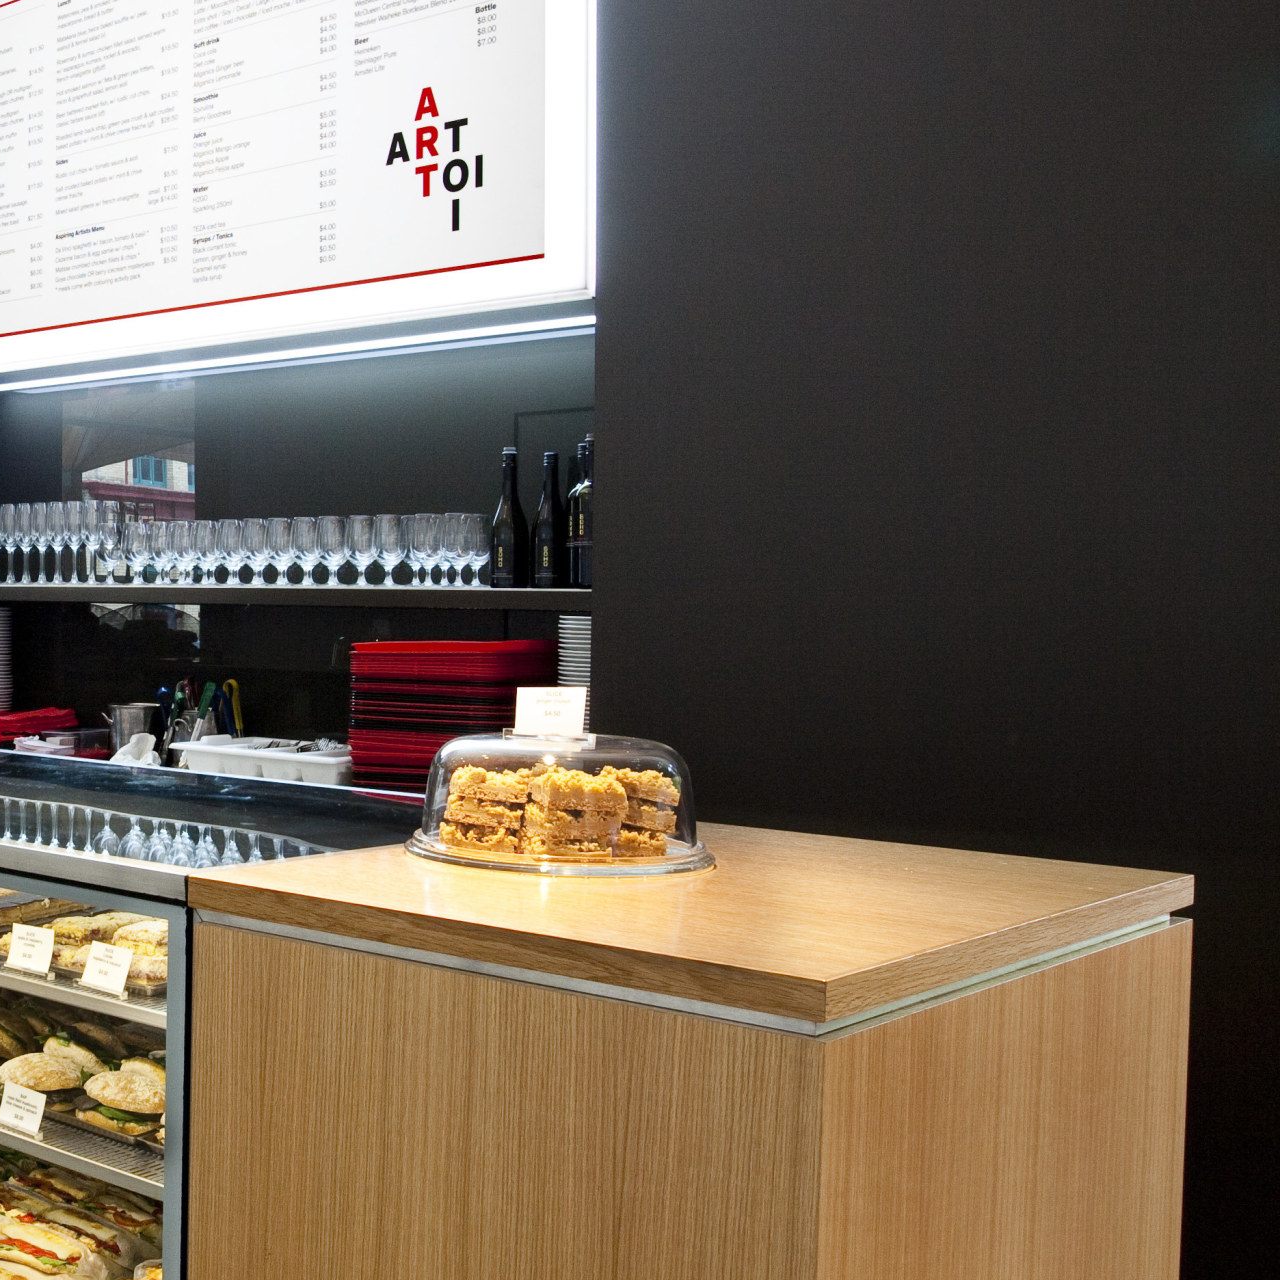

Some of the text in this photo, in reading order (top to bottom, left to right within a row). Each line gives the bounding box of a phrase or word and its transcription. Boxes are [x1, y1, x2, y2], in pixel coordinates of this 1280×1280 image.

[354, 3, 496, 46] Beer Bottle
[194, 37, 220, 50] Soft drink
[477, 36, 496, 48] $7.00
[56, 232, 74, 240] Aspiring
[193, 237, 211, 245] Syrups
